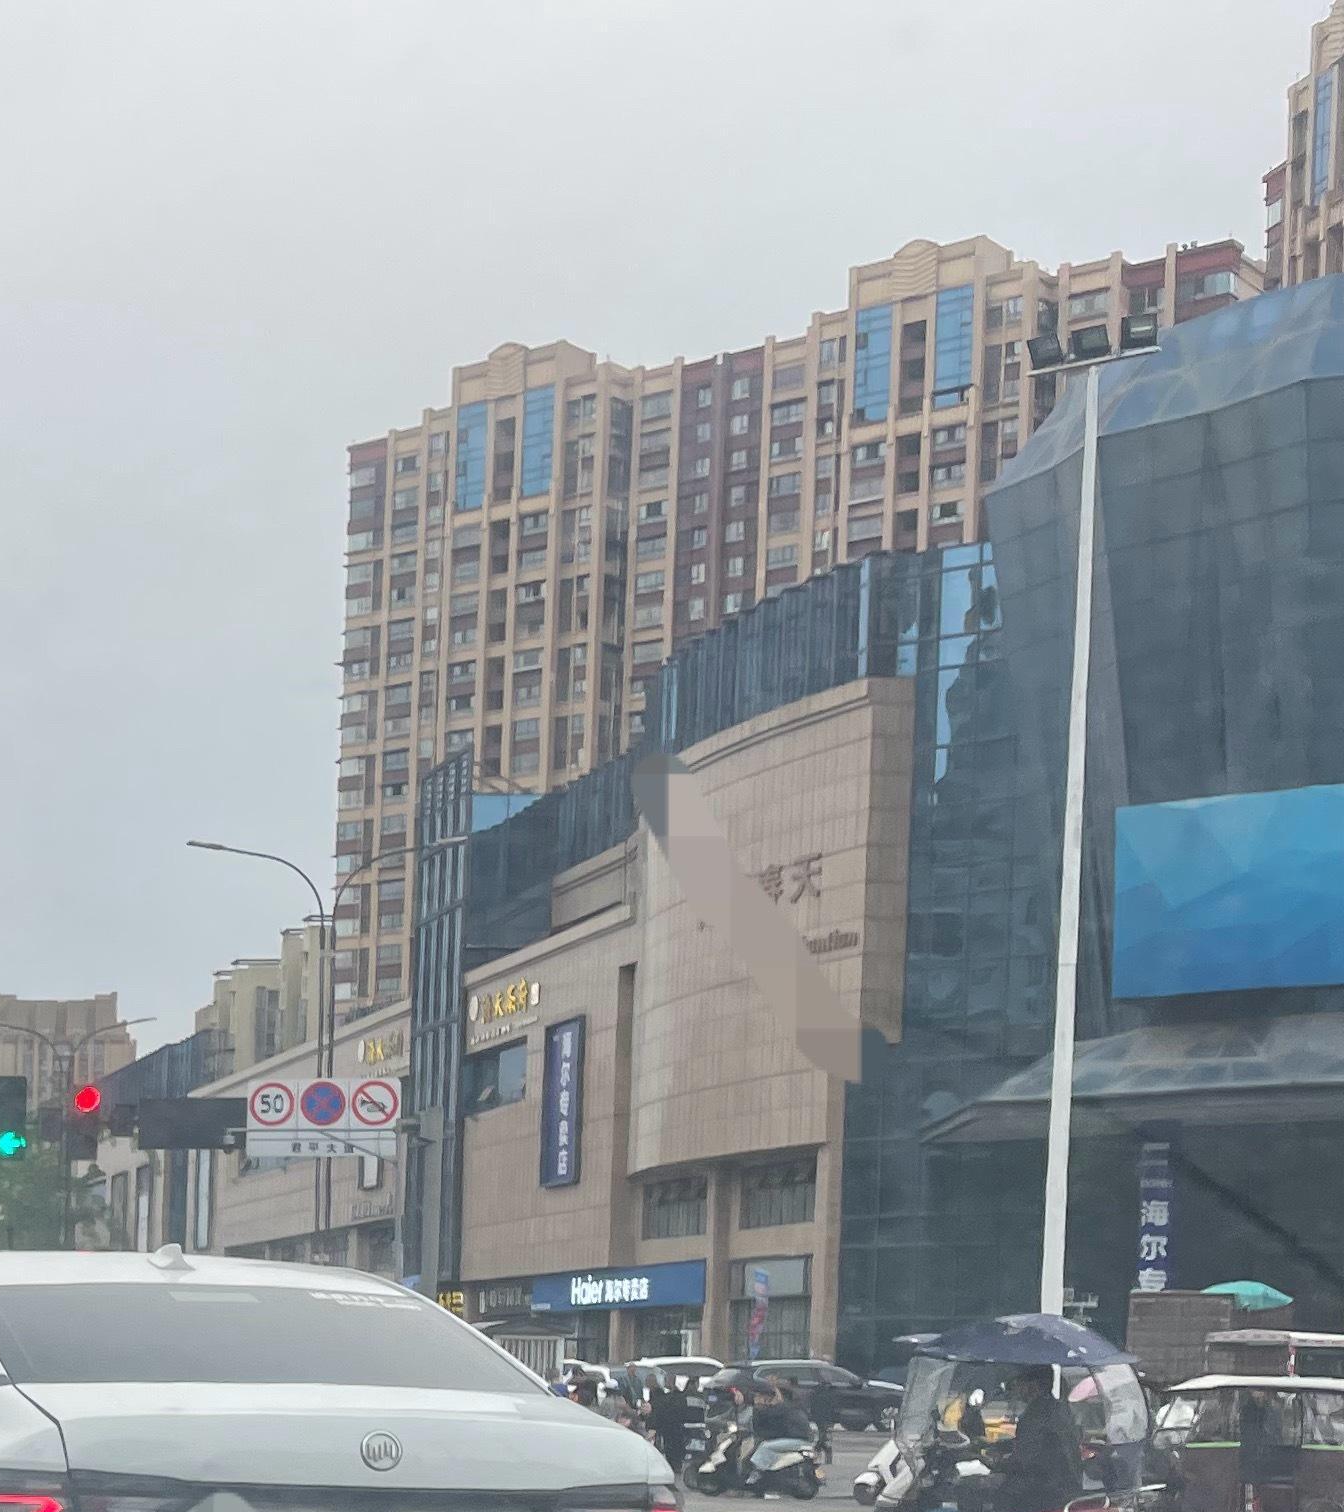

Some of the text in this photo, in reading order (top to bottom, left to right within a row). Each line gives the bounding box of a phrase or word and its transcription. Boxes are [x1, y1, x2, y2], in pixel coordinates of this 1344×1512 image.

[260, 1093, 284, 1114] 50
[570, 1274, 649, 1305] Haier 海尔专卖店
